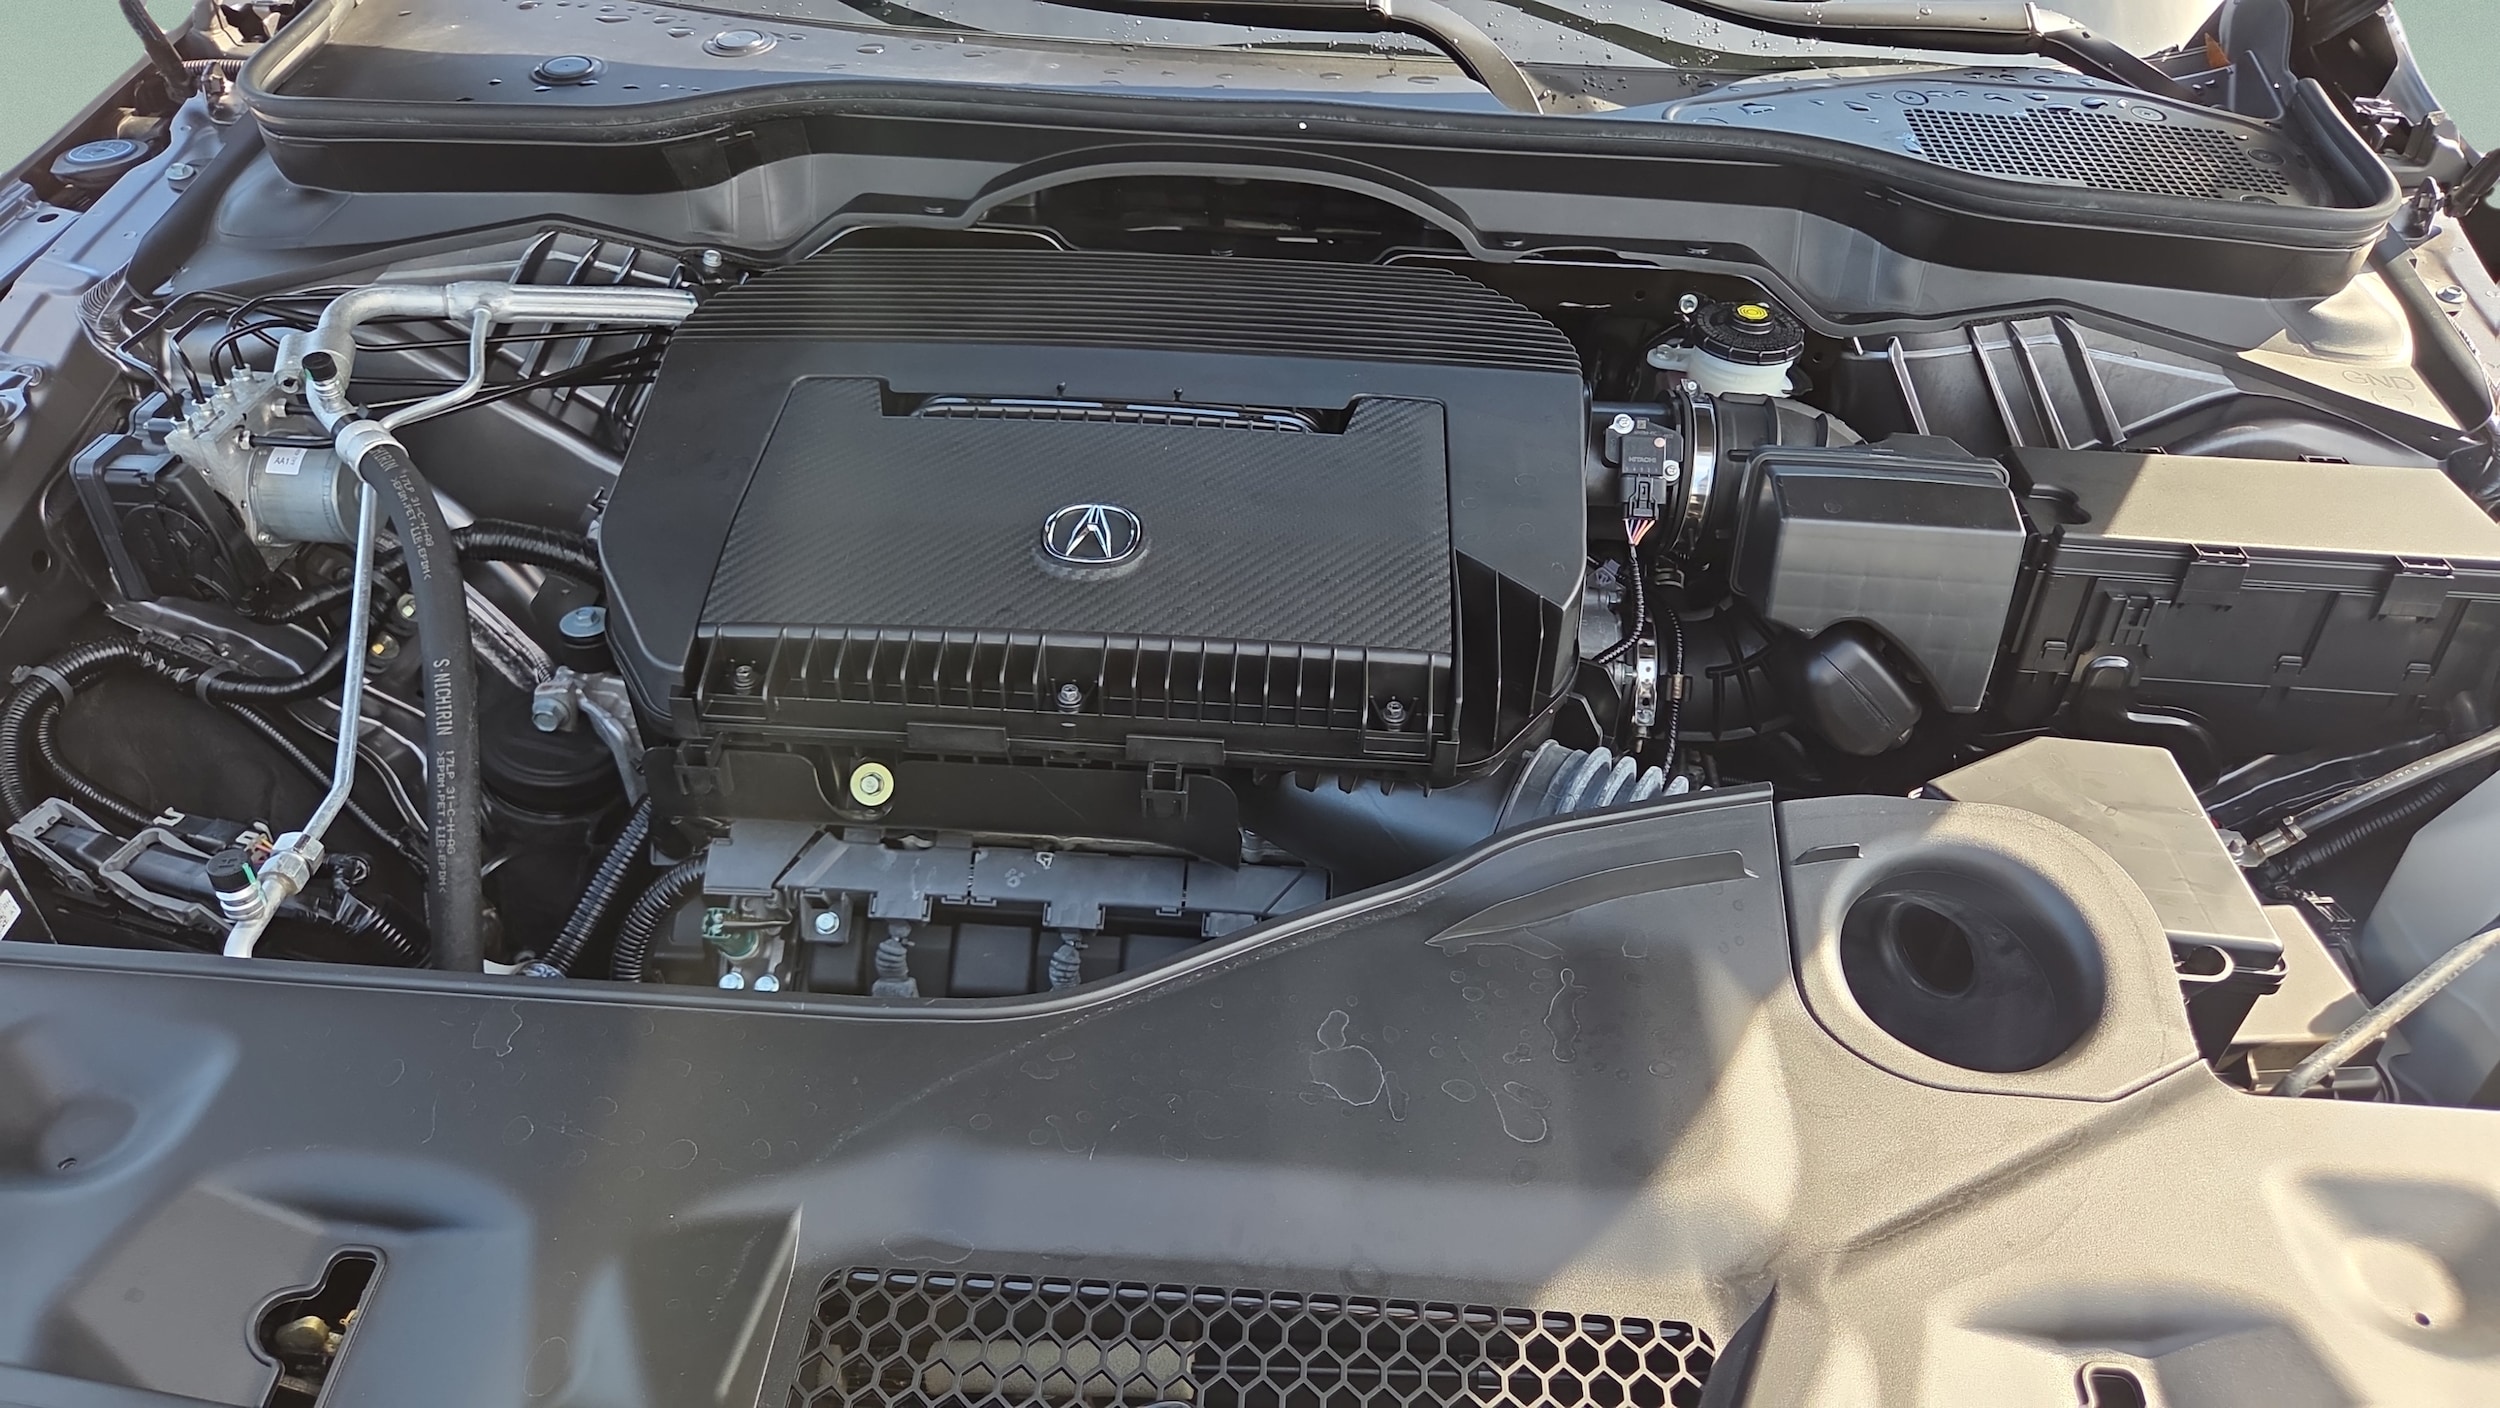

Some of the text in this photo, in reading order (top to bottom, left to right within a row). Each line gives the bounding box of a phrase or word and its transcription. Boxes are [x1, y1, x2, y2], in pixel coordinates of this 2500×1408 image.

[2342, 369, 2416, 391] GND
[446, 750, 456, 780] 17LP
[2354, 765, 2420, 797] SUMITOMO
